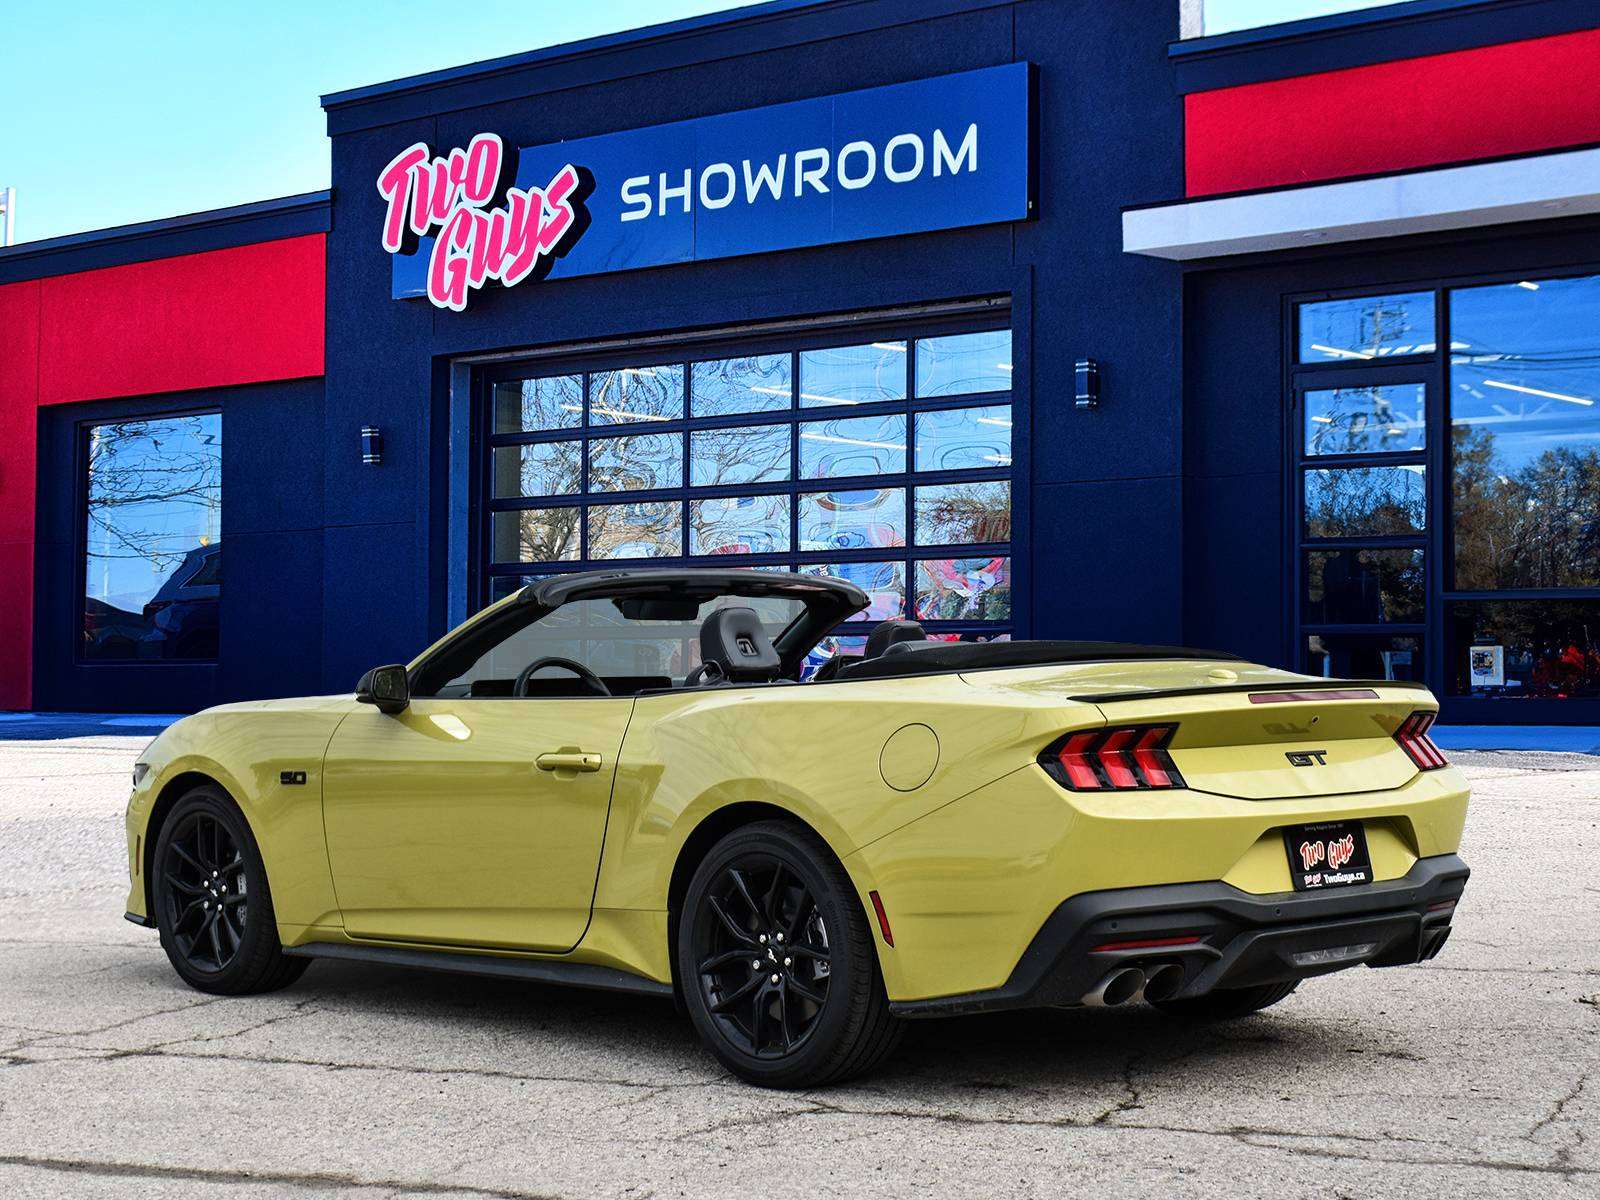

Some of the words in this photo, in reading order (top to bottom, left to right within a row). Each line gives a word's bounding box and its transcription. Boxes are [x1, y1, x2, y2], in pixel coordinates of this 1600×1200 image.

[621, 123, 978, 222] SHOWROOM
[1285, 750, 1327, 767] GT
[1323, 871, 1366, 884] TwoGuys.ca
